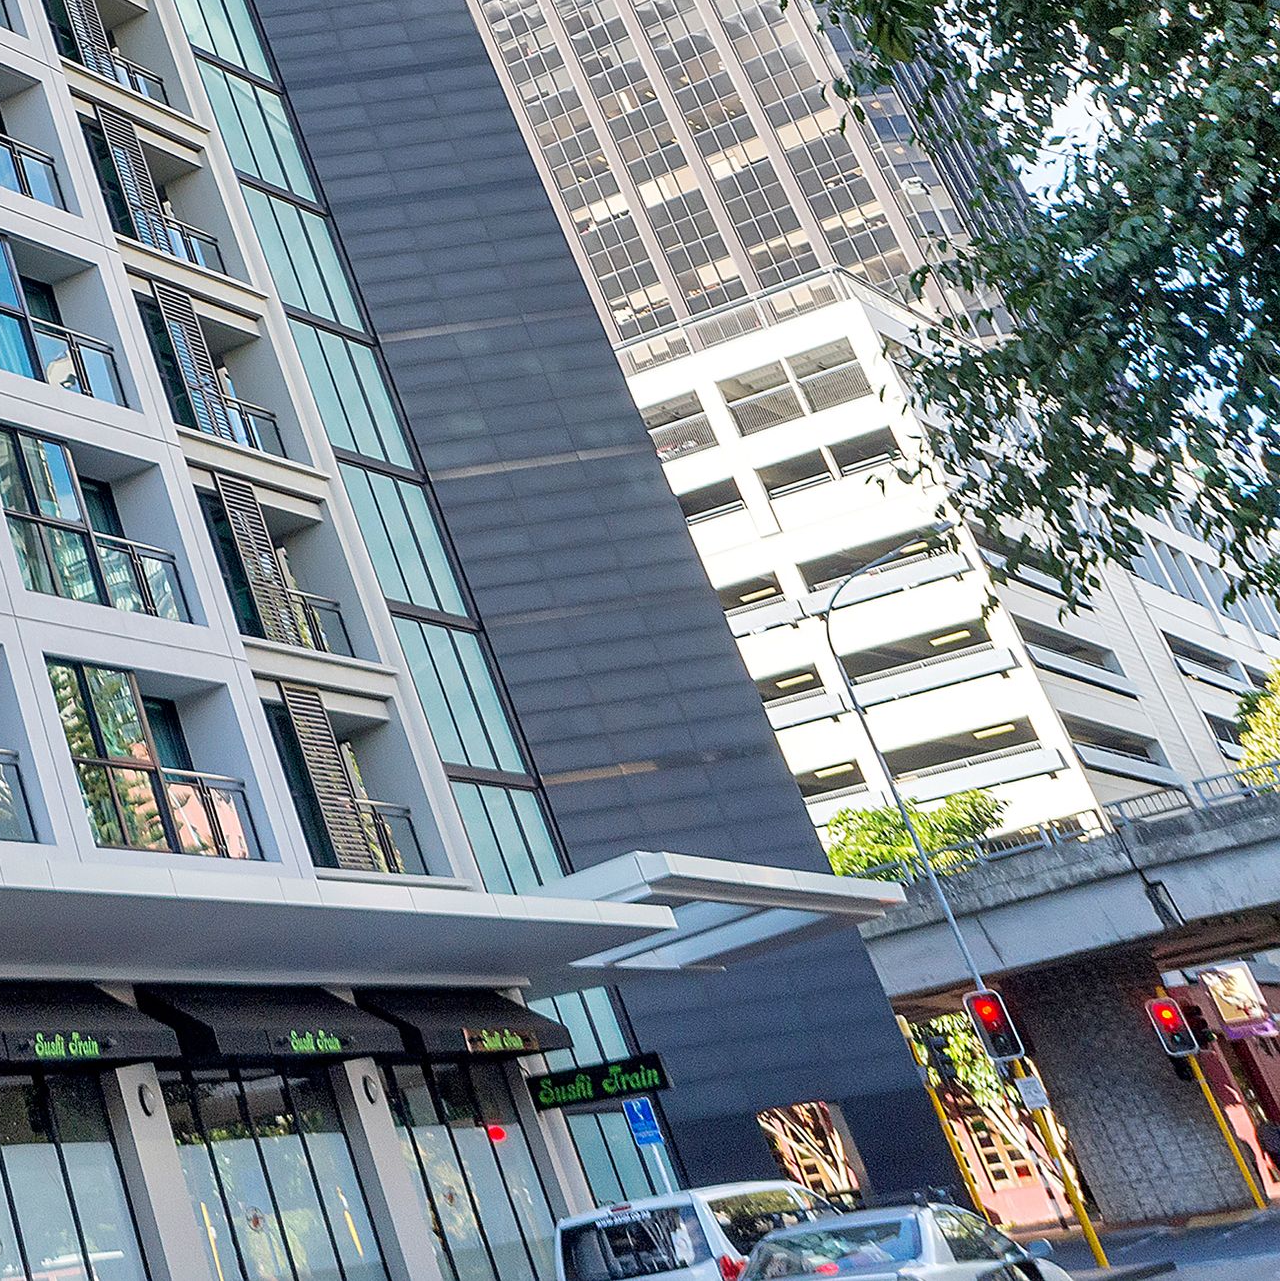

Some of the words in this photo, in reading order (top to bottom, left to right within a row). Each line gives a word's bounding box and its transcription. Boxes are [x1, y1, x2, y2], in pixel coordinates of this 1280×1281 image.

[35, 1032, 66, 1058] Sushi
[68, 1031, 100, 1056] Train
[539, 1073, 593, 1104] Sushi
[601, 1064, 659, 1094] Train
